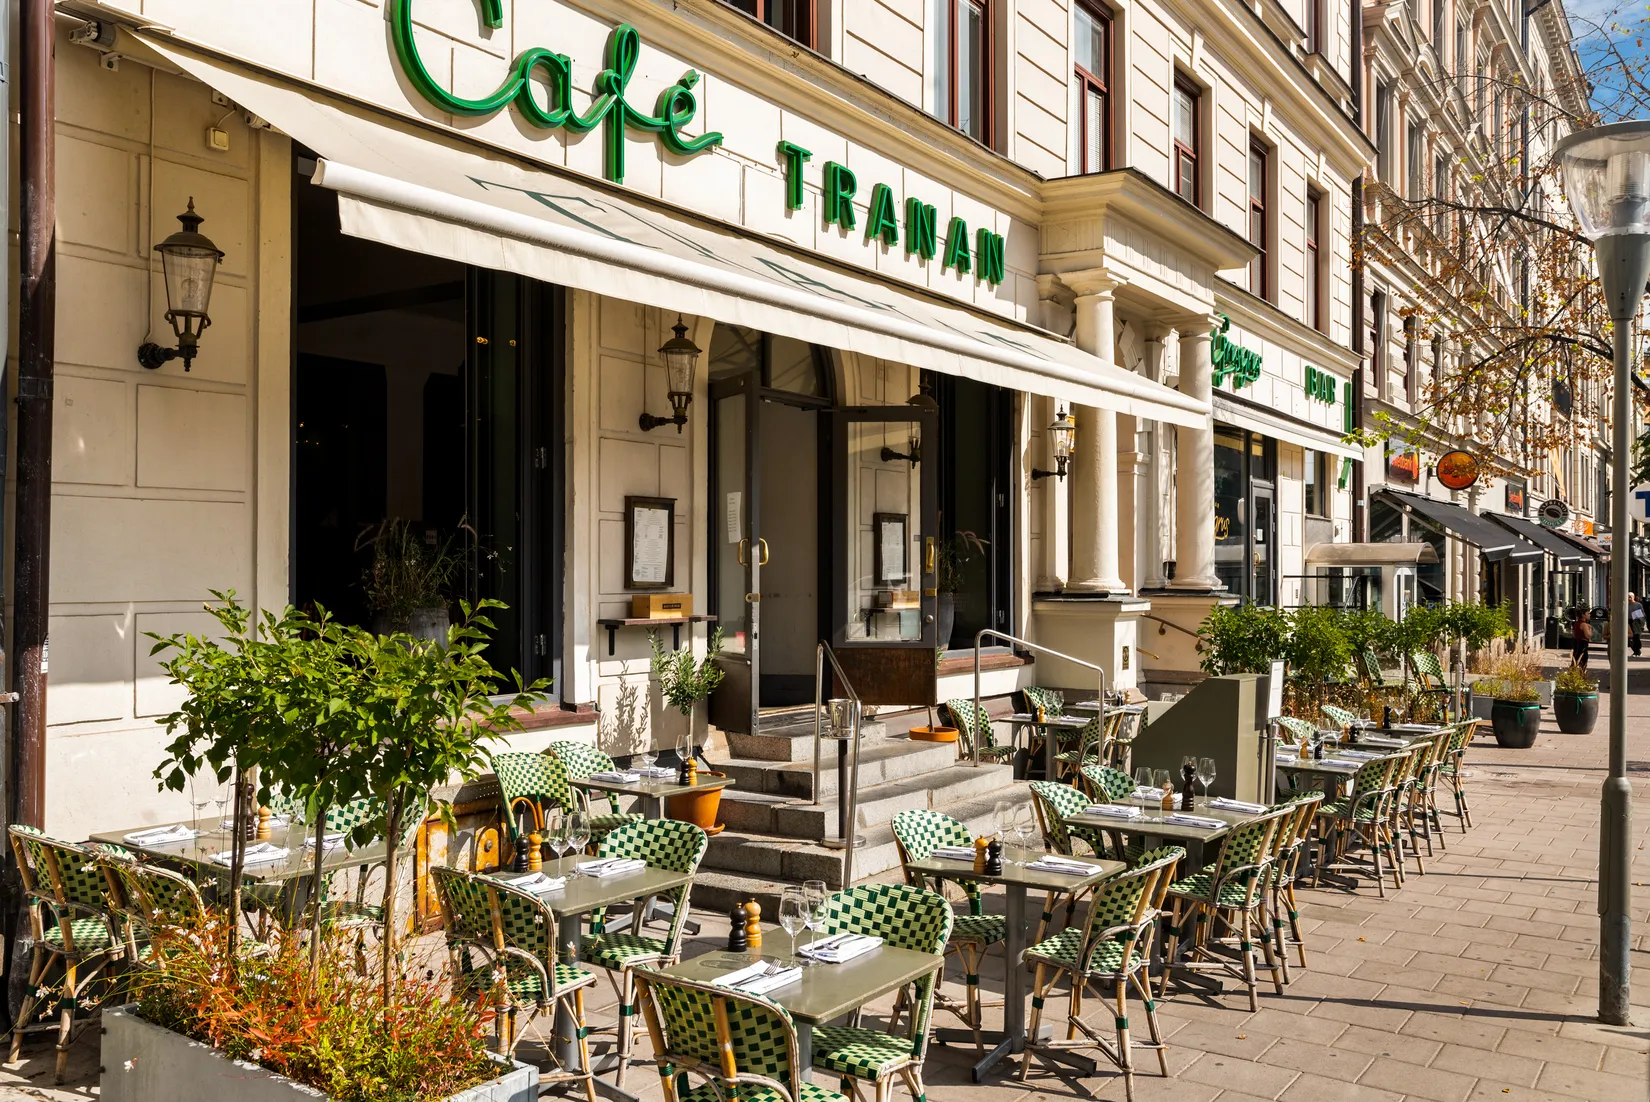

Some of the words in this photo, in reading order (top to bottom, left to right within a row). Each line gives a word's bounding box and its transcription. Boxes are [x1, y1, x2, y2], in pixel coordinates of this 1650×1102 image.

[391, 0, 723, 185] Café
[777, 140, 1005, 286] TRANAN
[1304, 365, 1336, 405] BAR
